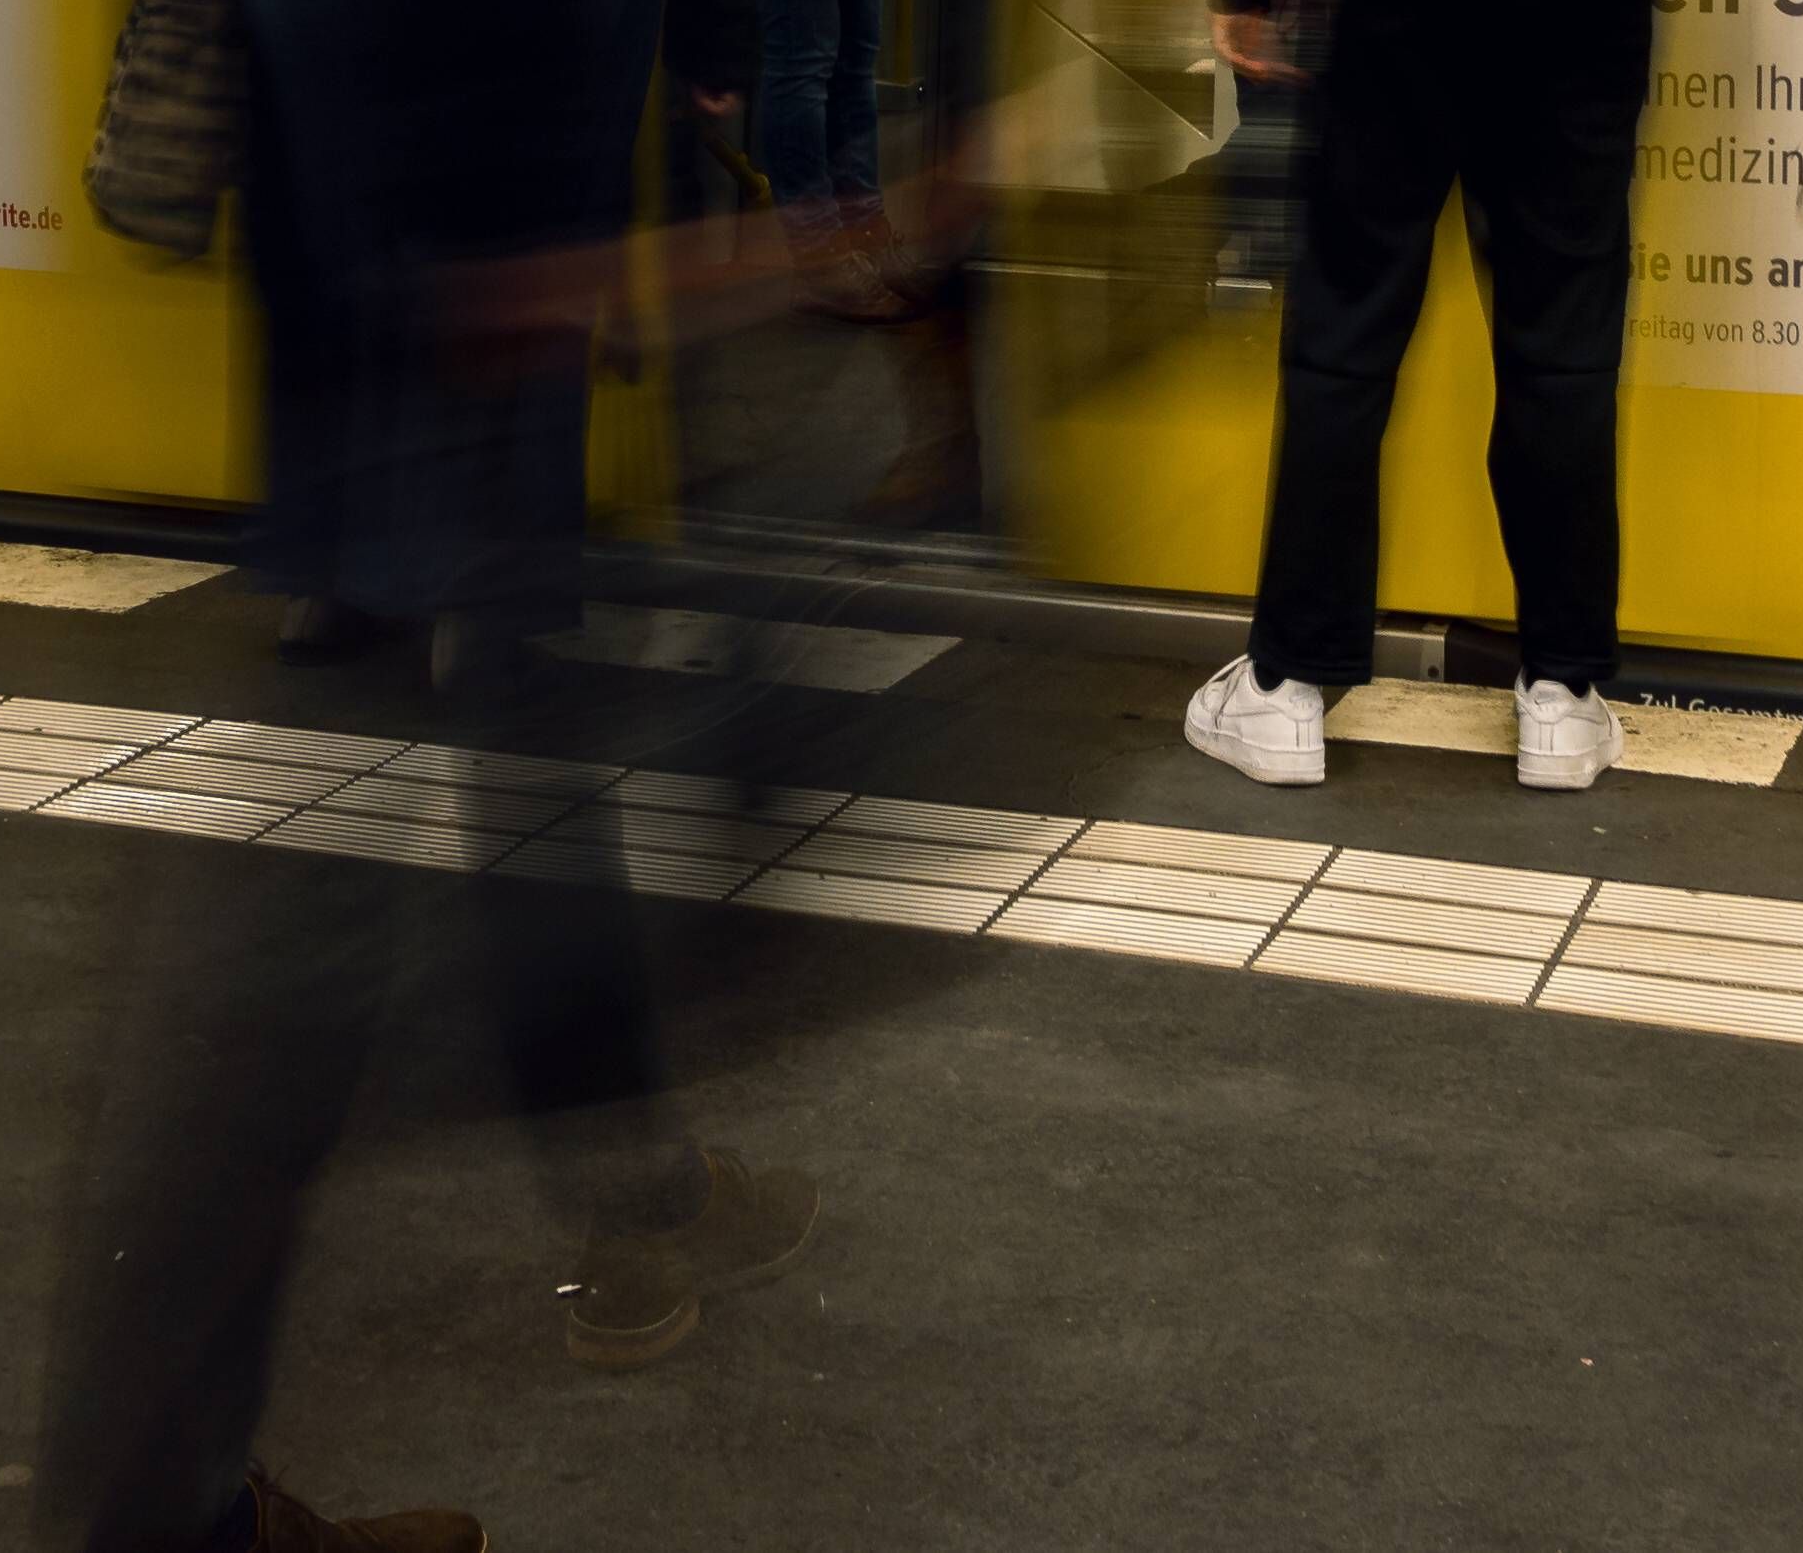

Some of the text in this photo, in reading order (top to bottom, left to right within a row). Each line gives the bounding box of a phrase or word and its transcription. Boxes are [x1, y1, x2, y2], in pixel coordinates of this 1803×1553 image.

[1628, 243, 1671, 282] ie
[1686, 255, 1753, 286] uns
[1629, 315, 1694, 346] reitag
[1704, 324, 1743, 342] von
